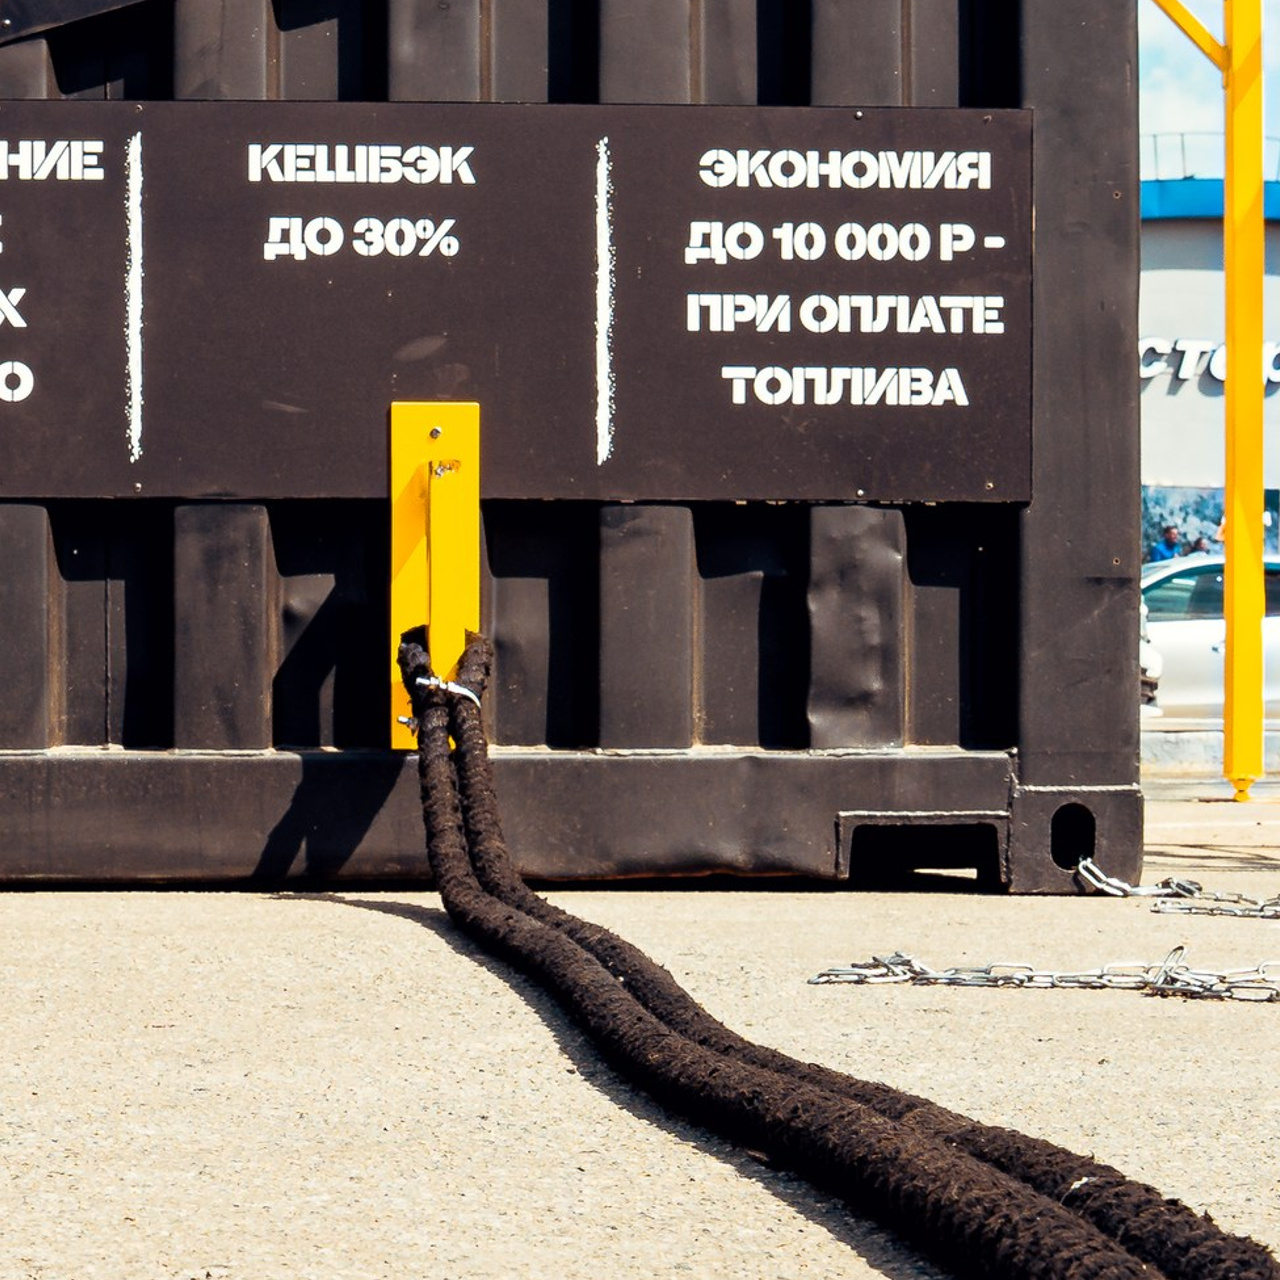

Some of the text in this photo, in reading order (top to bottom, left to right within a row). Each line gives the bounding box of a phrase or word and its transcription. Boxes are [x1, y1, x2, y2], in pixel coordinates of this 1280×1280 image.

[247, 144, 476, 184] КЕШБЭК
[698, 149, 992, 190] ЭКОНОМИЯ
[263, 216, 460, 261] ДО 30%
[684, 221, 765, 265] ДО
[686, 293, 1006, 335] ПРИ ОПЛАТЕ
[720, 366, 970, 406] ТОПЛИВА
